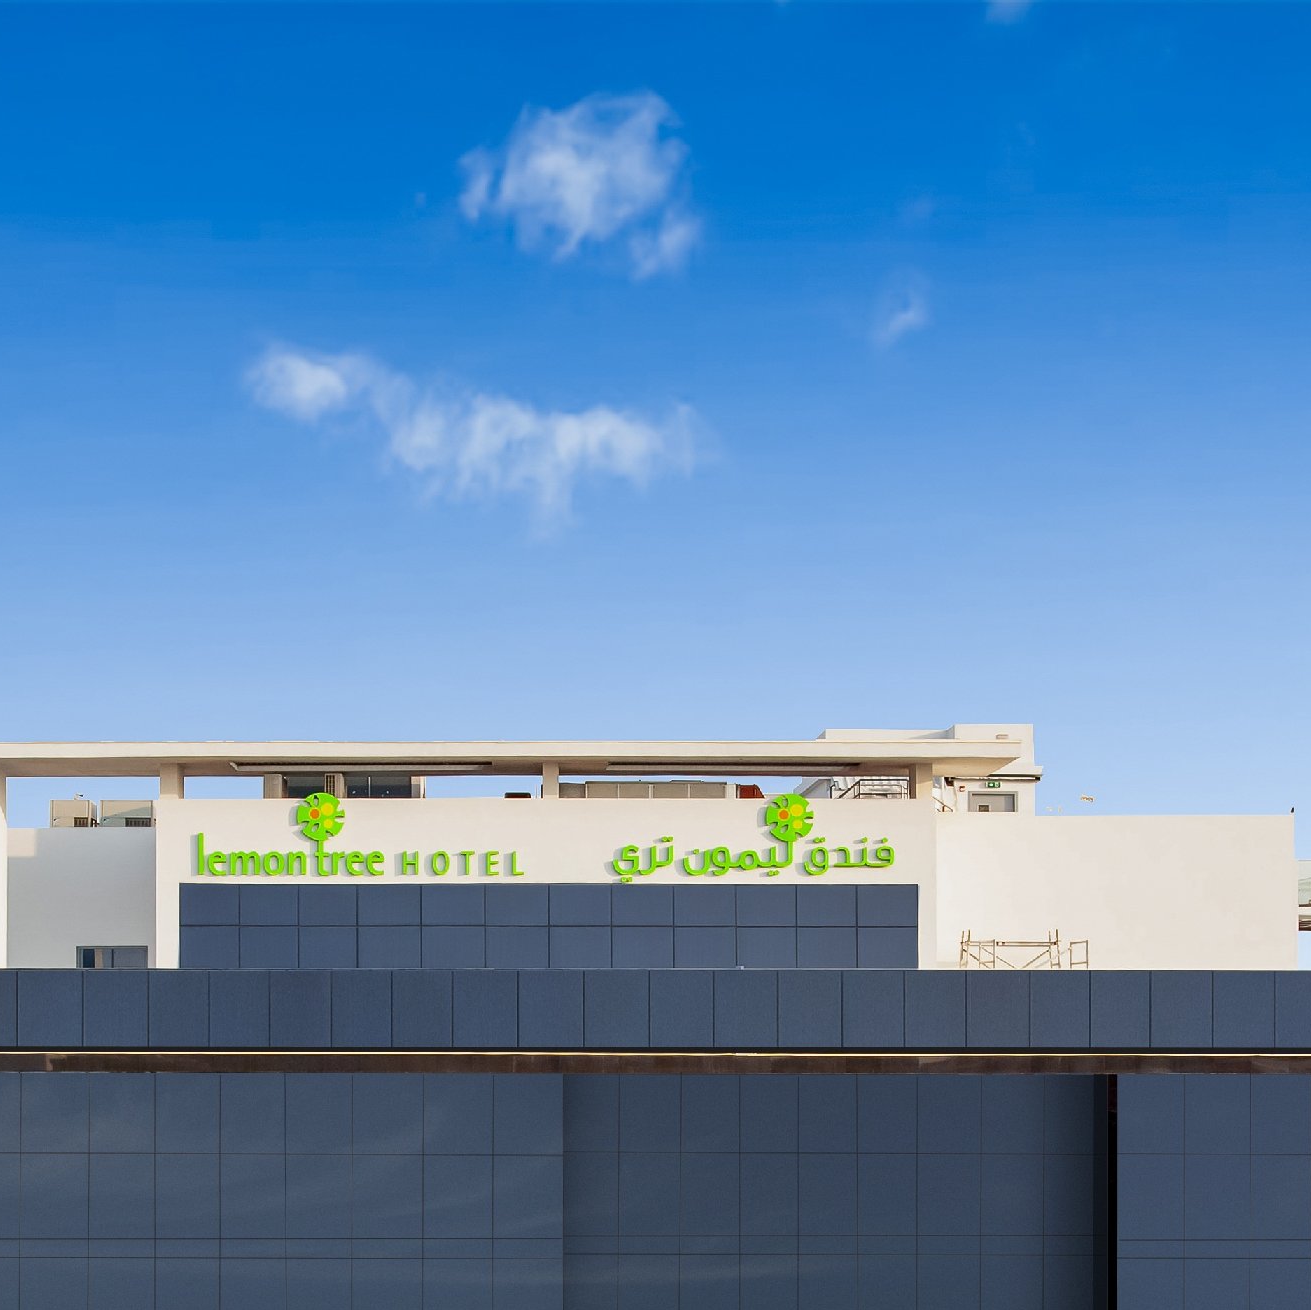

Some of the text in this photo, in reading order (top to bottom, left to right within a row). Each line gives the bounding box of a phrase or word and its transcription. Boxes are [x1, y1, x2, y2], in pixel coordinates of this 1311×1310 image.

[197, 832, 524, 876] lemon tree HOTEL
[612, 836, 895, 883] فندق ليمون تري
